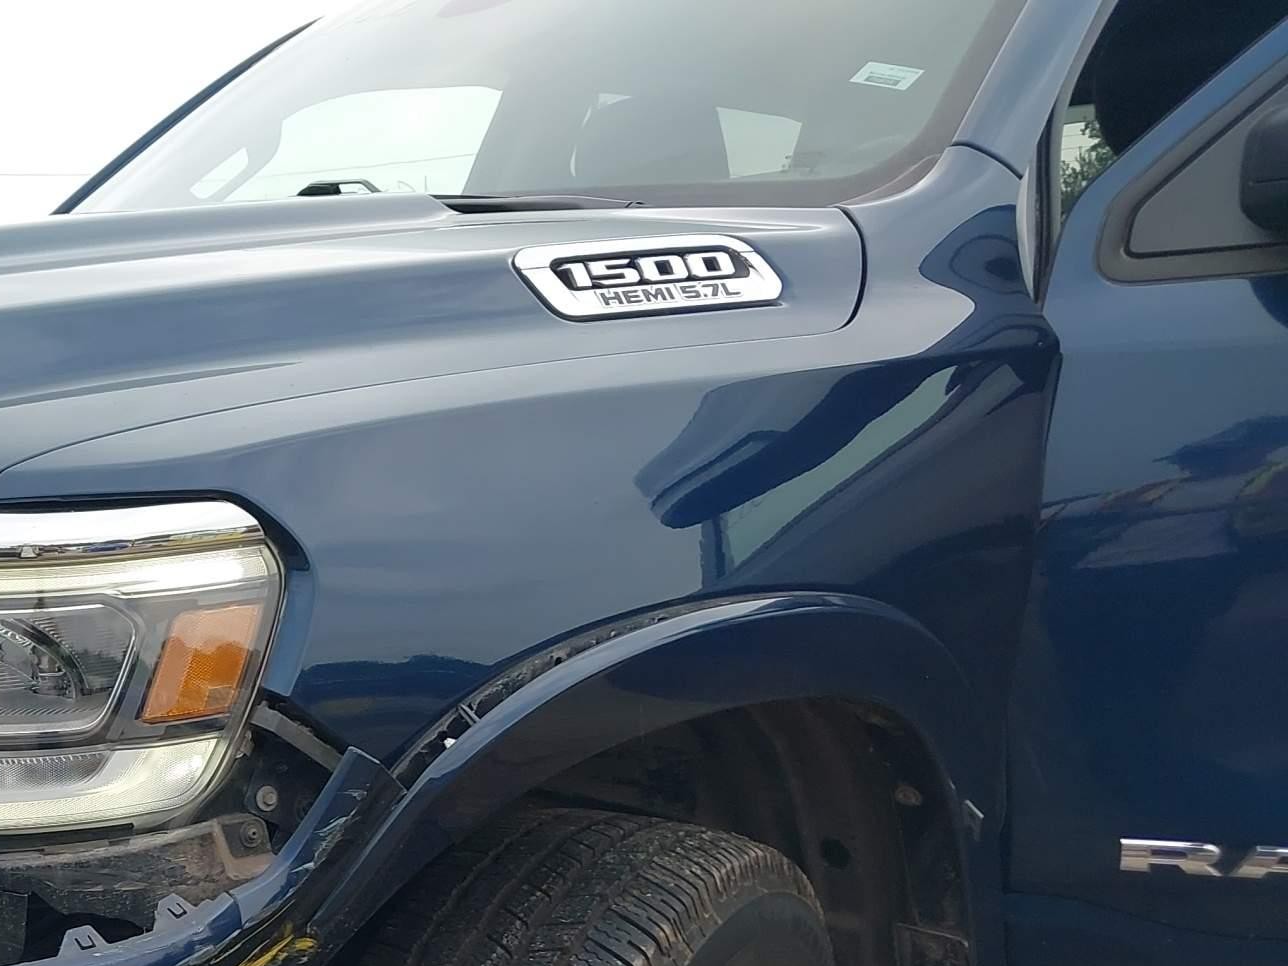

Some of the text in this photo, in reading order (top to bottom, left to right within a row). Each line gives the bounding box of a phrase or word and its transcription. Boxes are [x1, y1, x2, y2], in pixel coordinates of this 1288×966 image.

[556, 251, 735, 288] 1500
[600, 281, 742, 306] HEMI 5.7L
